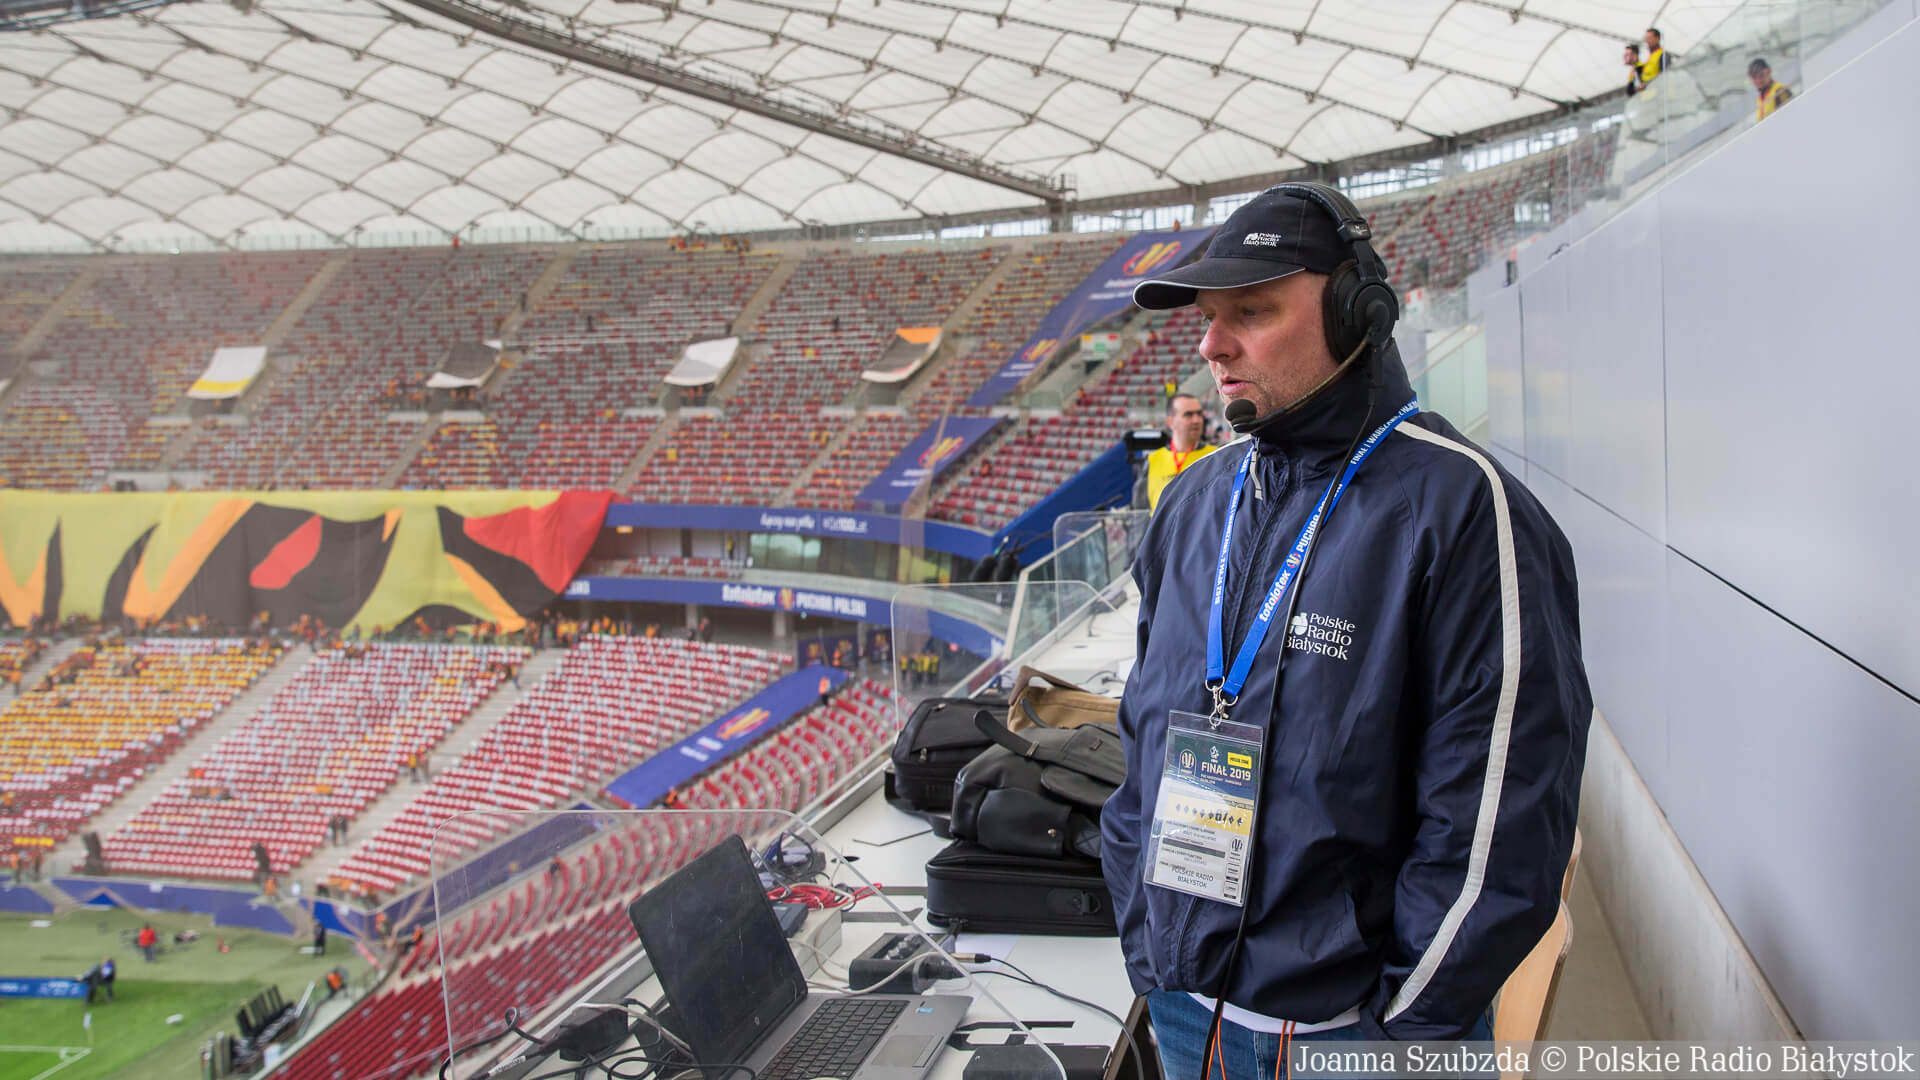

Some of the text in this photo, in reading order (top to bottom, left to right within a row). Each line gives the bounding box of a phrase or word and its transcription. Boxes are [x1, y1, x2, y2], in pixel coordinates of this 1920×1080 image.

[1259, 570, 1291, 622] totolotek
[1310, 613, 1356, 633] Polskie
[1307, 625, 1352, 646] Radio
[1201, 761, 1228, 777] FINAŁ
[1229, 767, 1251, 781] 2019
[1195, 871, 1214, 882] RADIO
